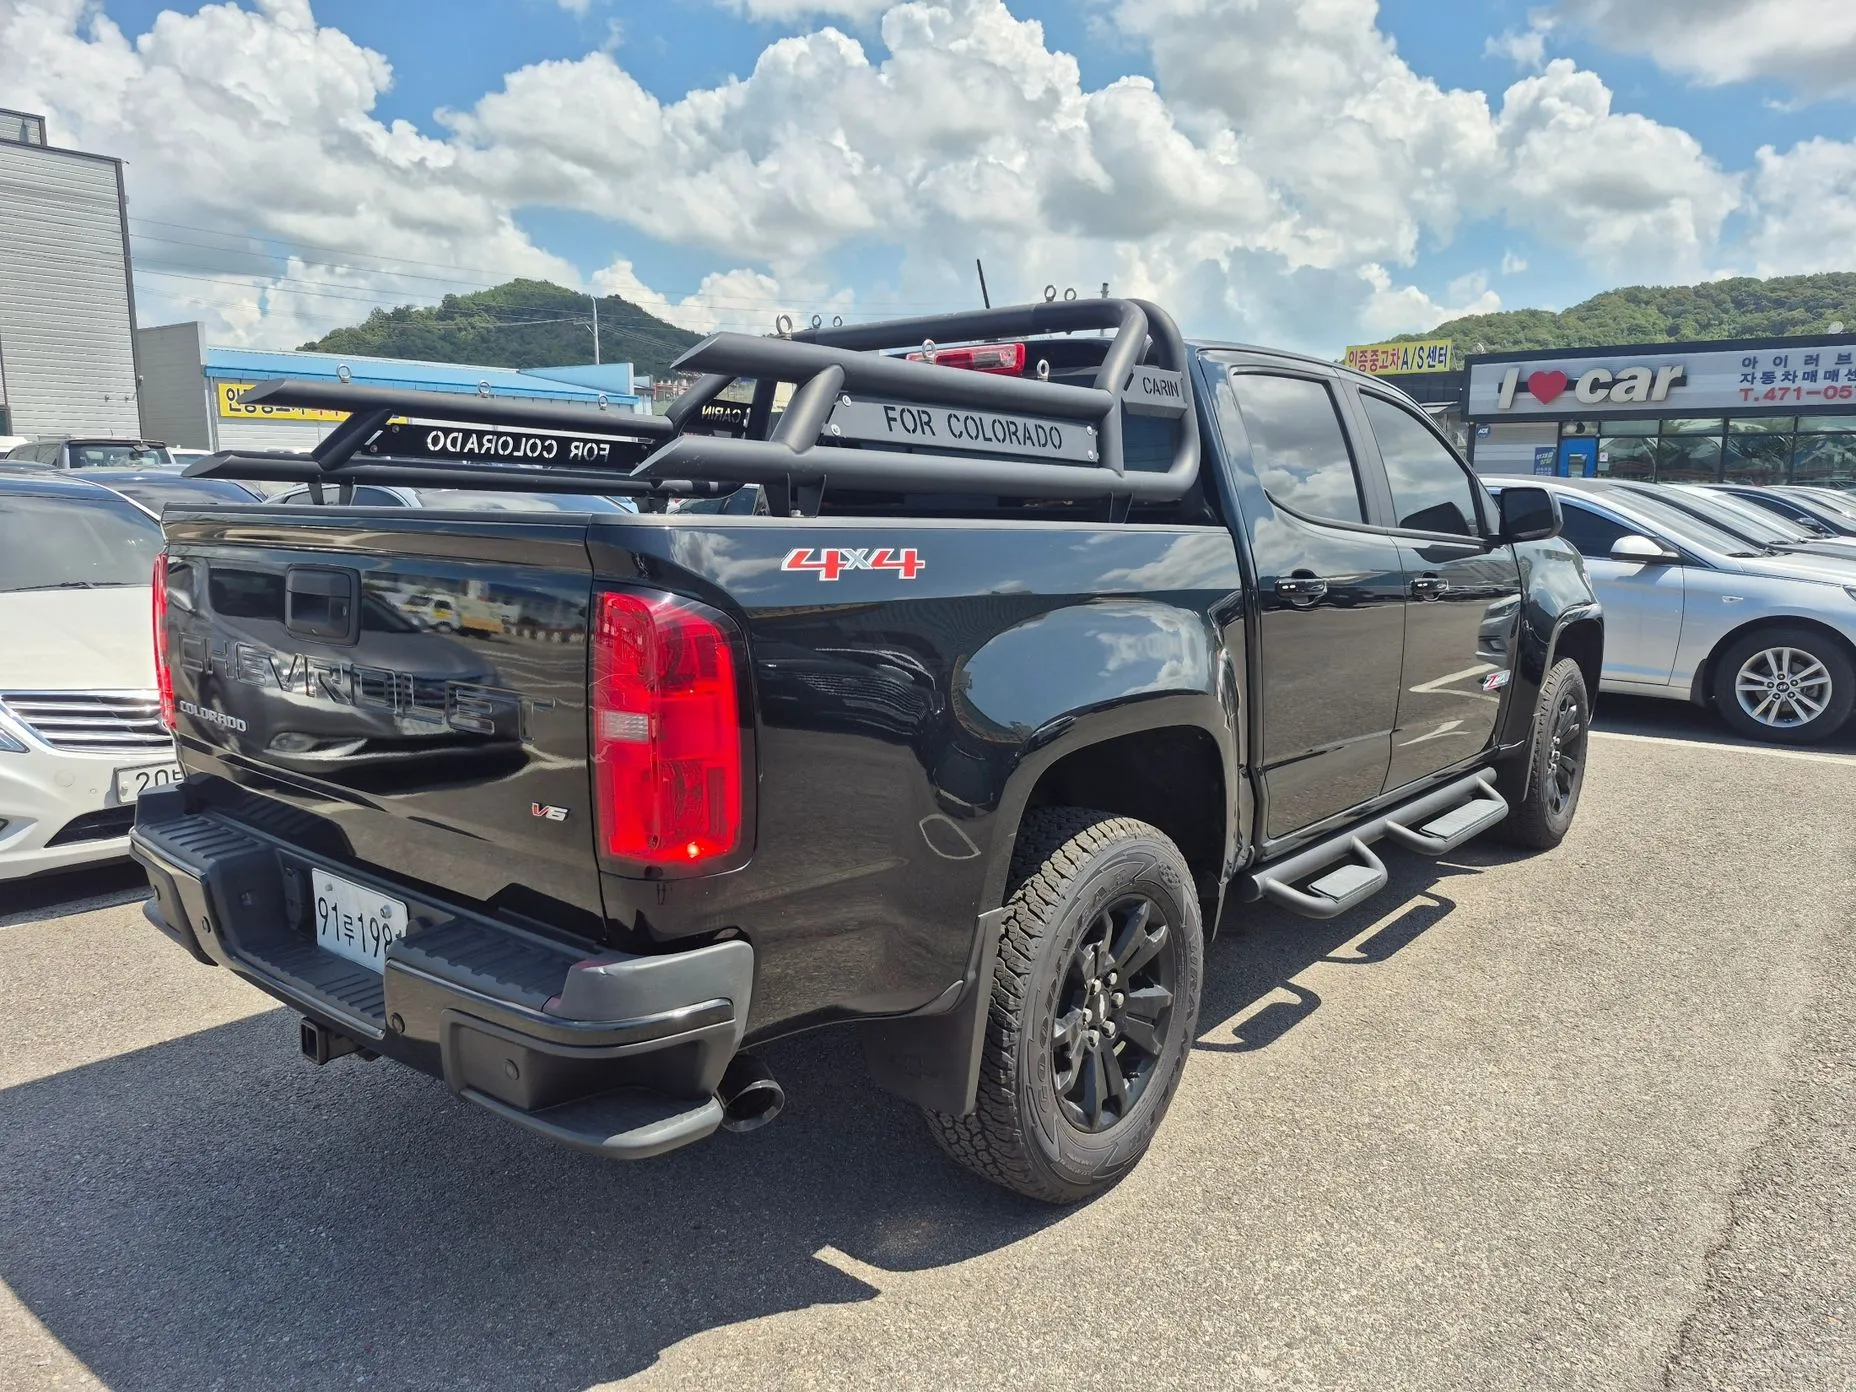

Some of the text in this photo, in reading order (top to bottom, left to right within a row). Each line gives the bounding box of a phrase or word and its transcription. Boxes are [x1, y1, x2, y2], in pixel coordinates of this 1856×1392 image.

[1142, 376, 1180, 398] CARIN
[1574, 364, 1685, 404] car
[1739, 385, 1856, 402] T.471-05
[882, 405, 1063, 451] FOR COLORADO
[178, 632, 557, 742] CHEVROLET
[179, 700, 248, 733] COLORADO
[532, 801, 569, 822] V6
